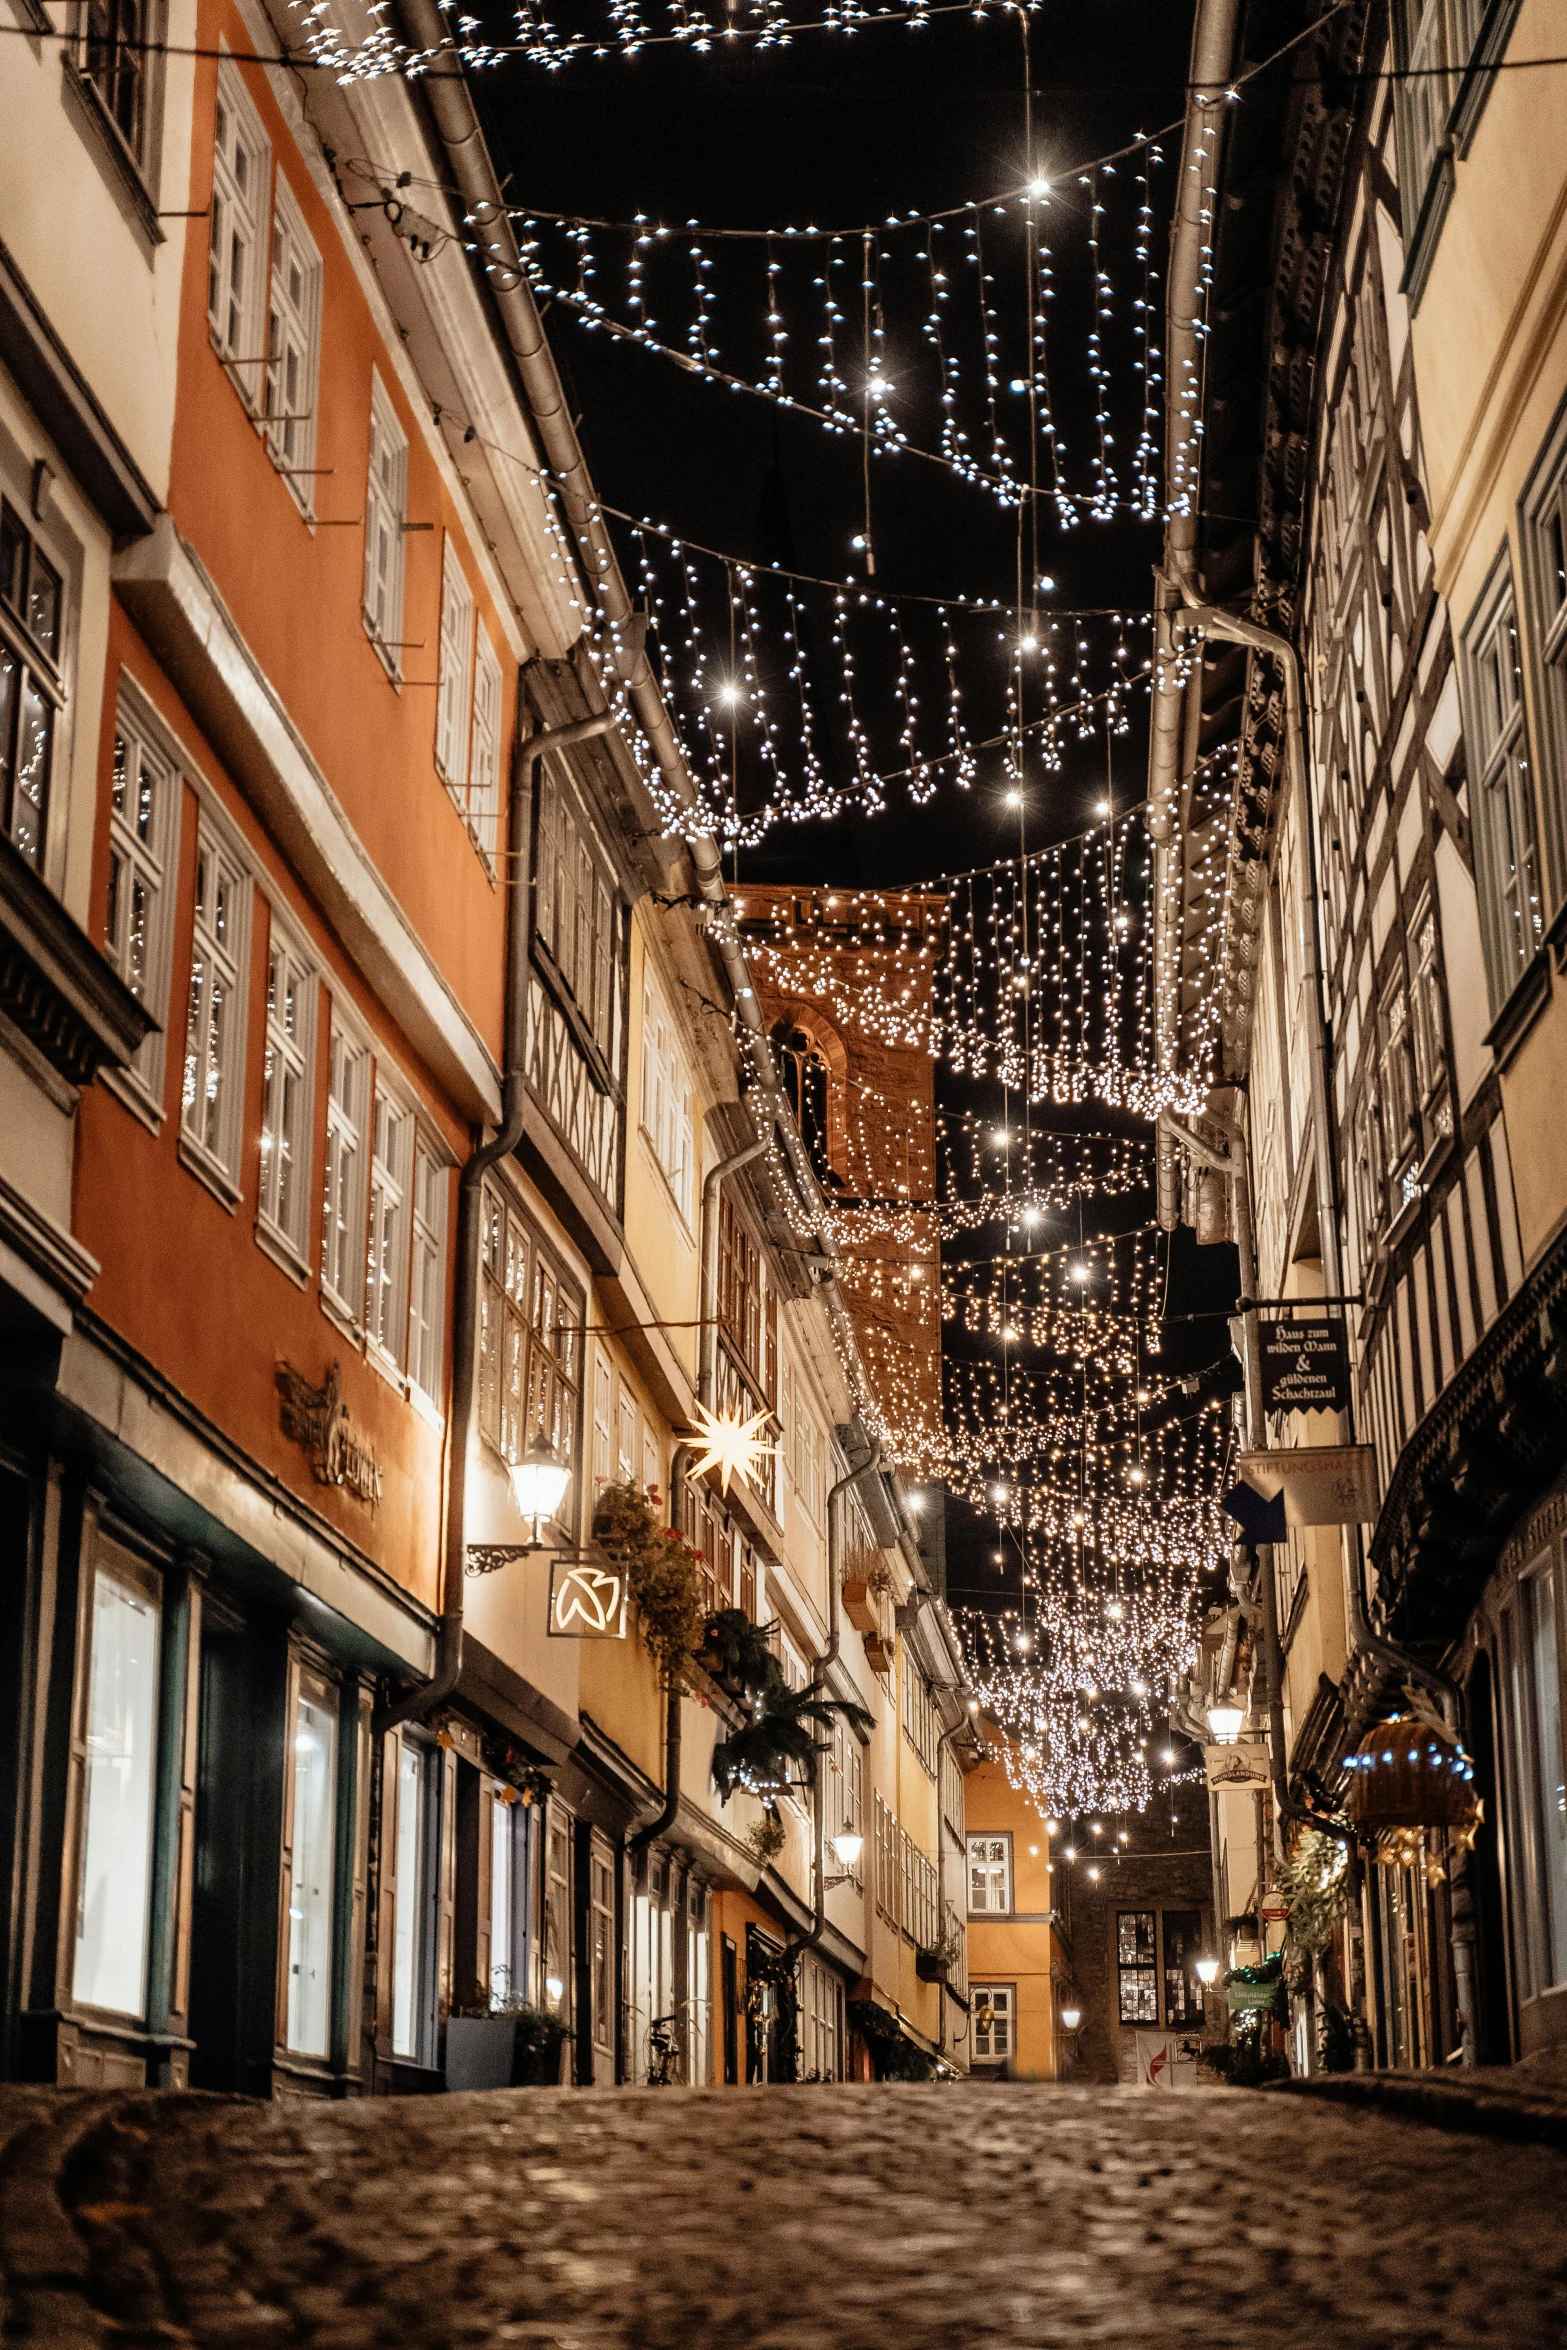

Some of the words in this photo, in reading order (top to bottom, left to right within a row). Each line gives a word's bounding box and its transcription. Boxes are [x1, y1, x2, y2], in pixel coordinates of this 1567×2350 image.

[1275, 1325, 1305, 1341] Haus
[1307, 1329, 1329, 1338] zum
[1266, 1342, 1301, 1354] wilden
[1303, 1340, 1337, 1352] Mann
[1295, 1353, 1311, 1372] &
[1279, 1373, 1328, 1388] güldenen
[1212, 1770, 1265, 1784] MUNDLANDUNG
